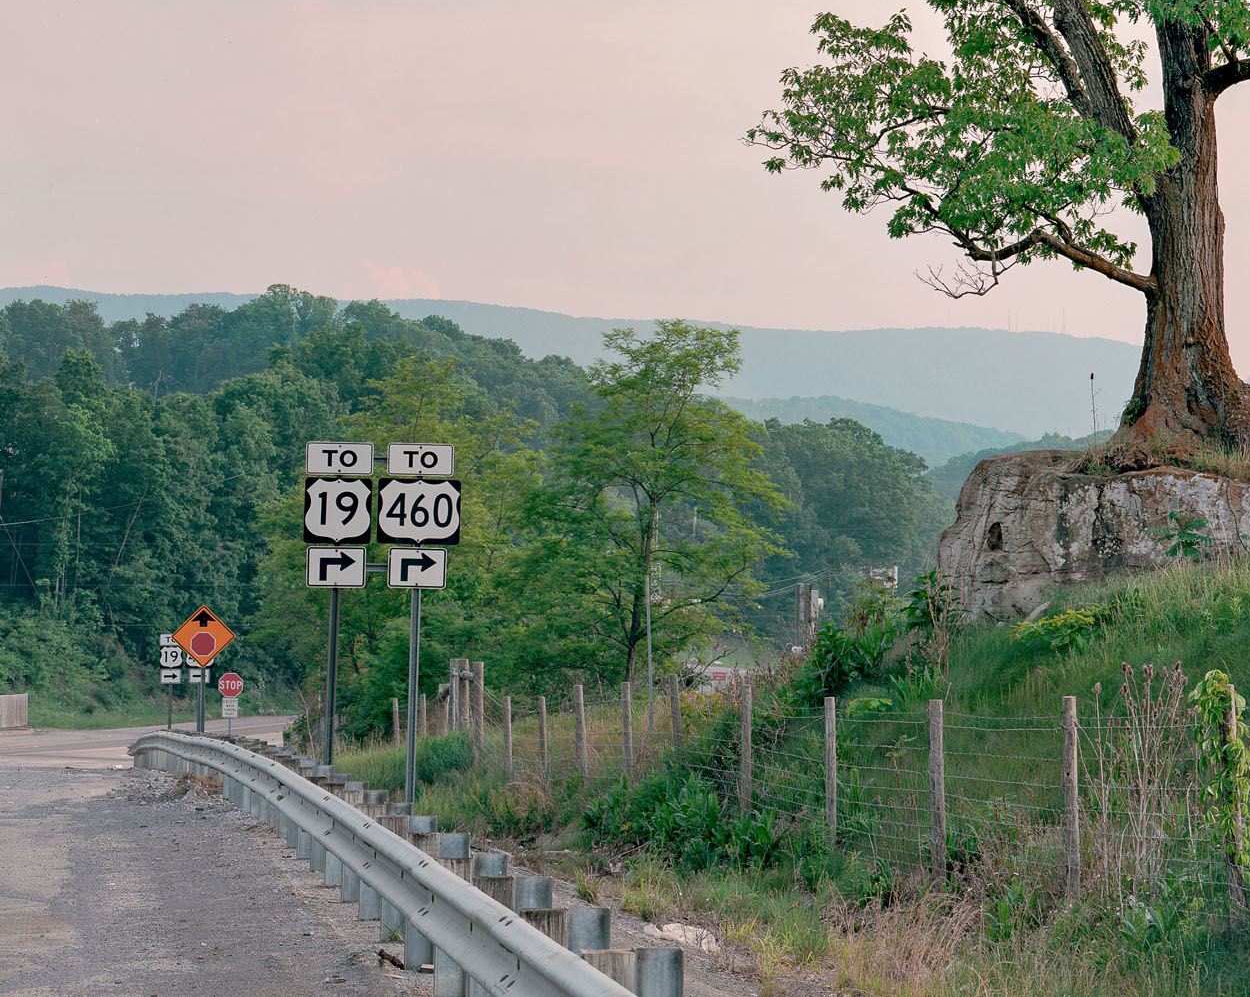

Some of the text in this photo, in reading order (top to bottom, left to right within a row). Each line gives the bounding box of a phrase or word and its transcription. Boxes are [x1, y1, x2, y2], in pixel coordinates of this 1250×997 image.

[322, 449, 358, 467] TO
[403, 450, 438, 469] TO
[318, 491, 359, 526] 19
[385, 492, 453, 528] 460
[164, 650, 179, 662] 19
[219, 680, 242, 690] STOP
